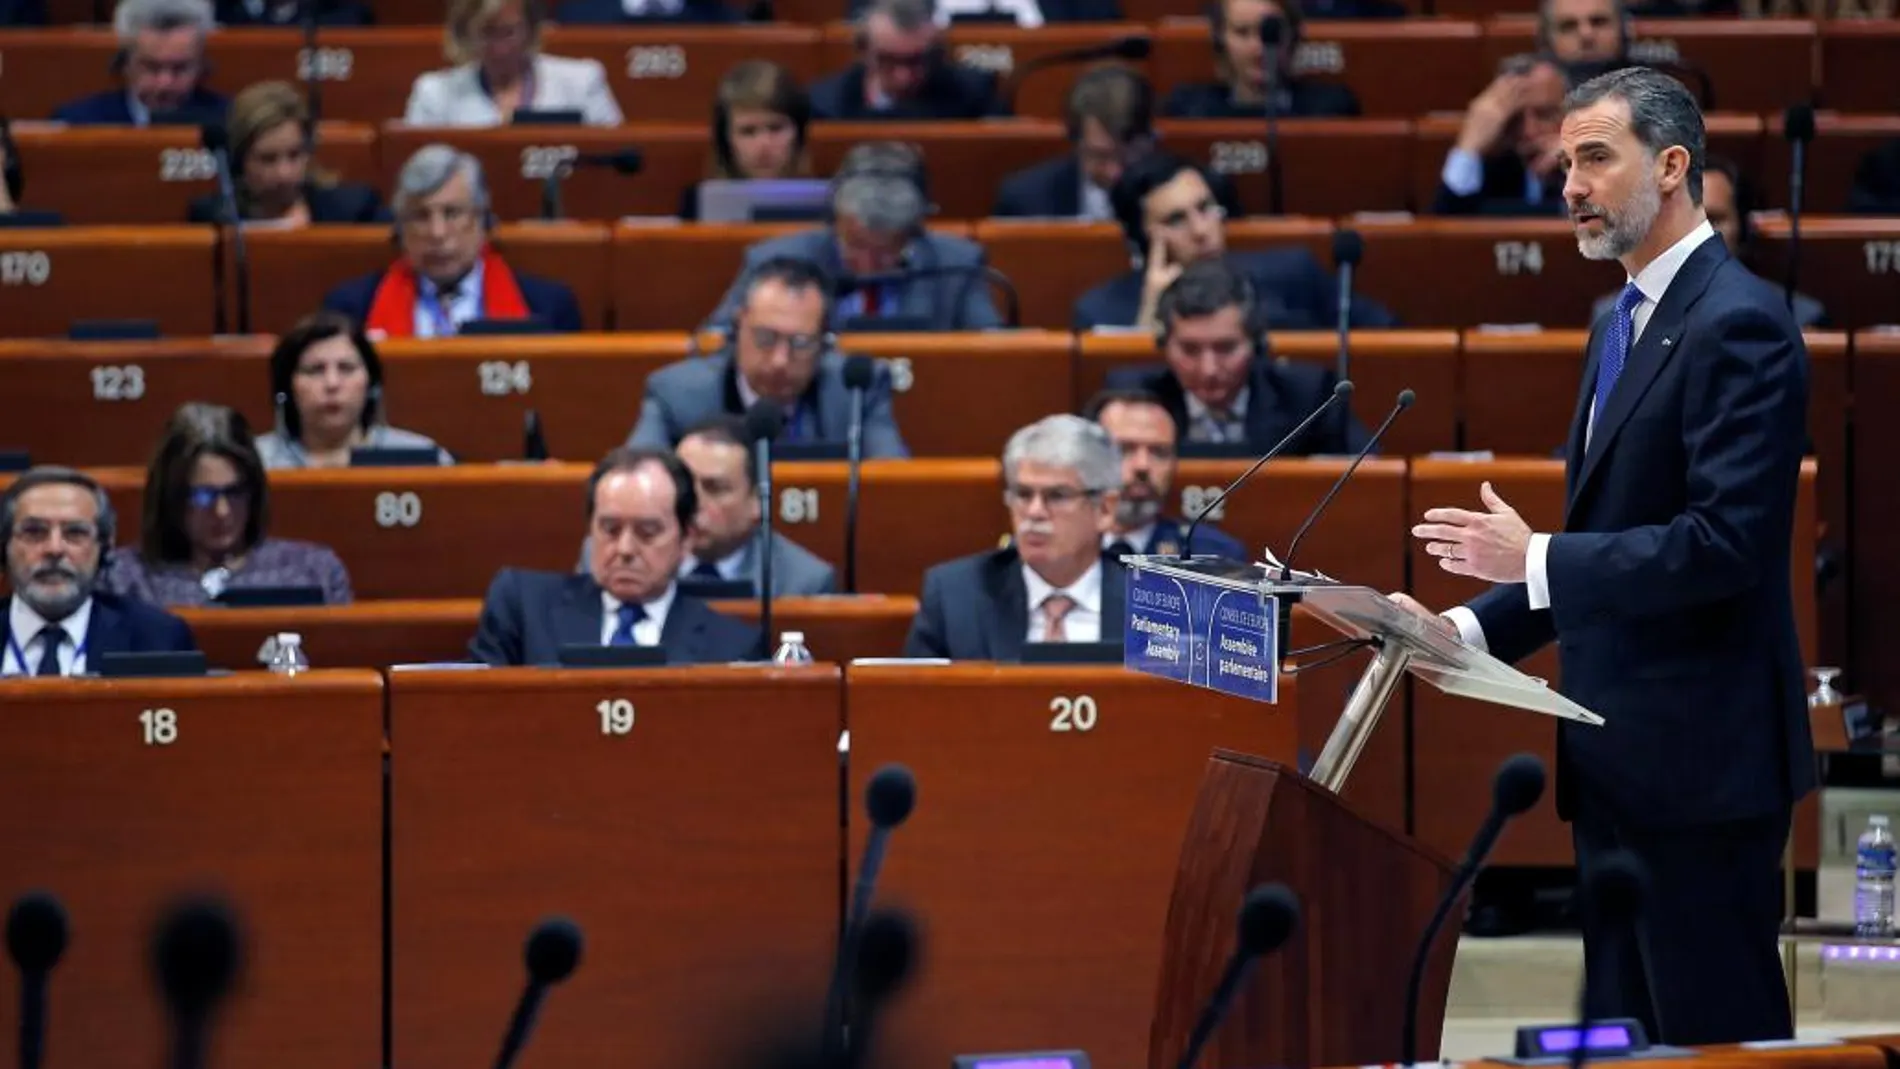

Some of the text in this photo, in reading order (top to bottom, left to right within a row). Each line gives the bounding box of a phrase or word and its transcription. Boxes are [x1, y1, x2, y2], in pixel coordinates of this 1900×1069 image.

[0, 250, 51, 286] 170
[1494, 241, 1544, 275] 174
[90, 364, 146, 400] 123
[477, 360, 532, 396] 124
[375, 490, 421, 527] 80
[781, 487, 818, 523] 81
[1181, 485, 1226, 521] 82
[1131, 613, 1180, 643] Parliamentary
[1145, 640, 1180, 665] Assembly
[139, 708, 178, 745] 18
[596, 698, 635, 734] 19
[1050, 695, 1097, 731] 20
